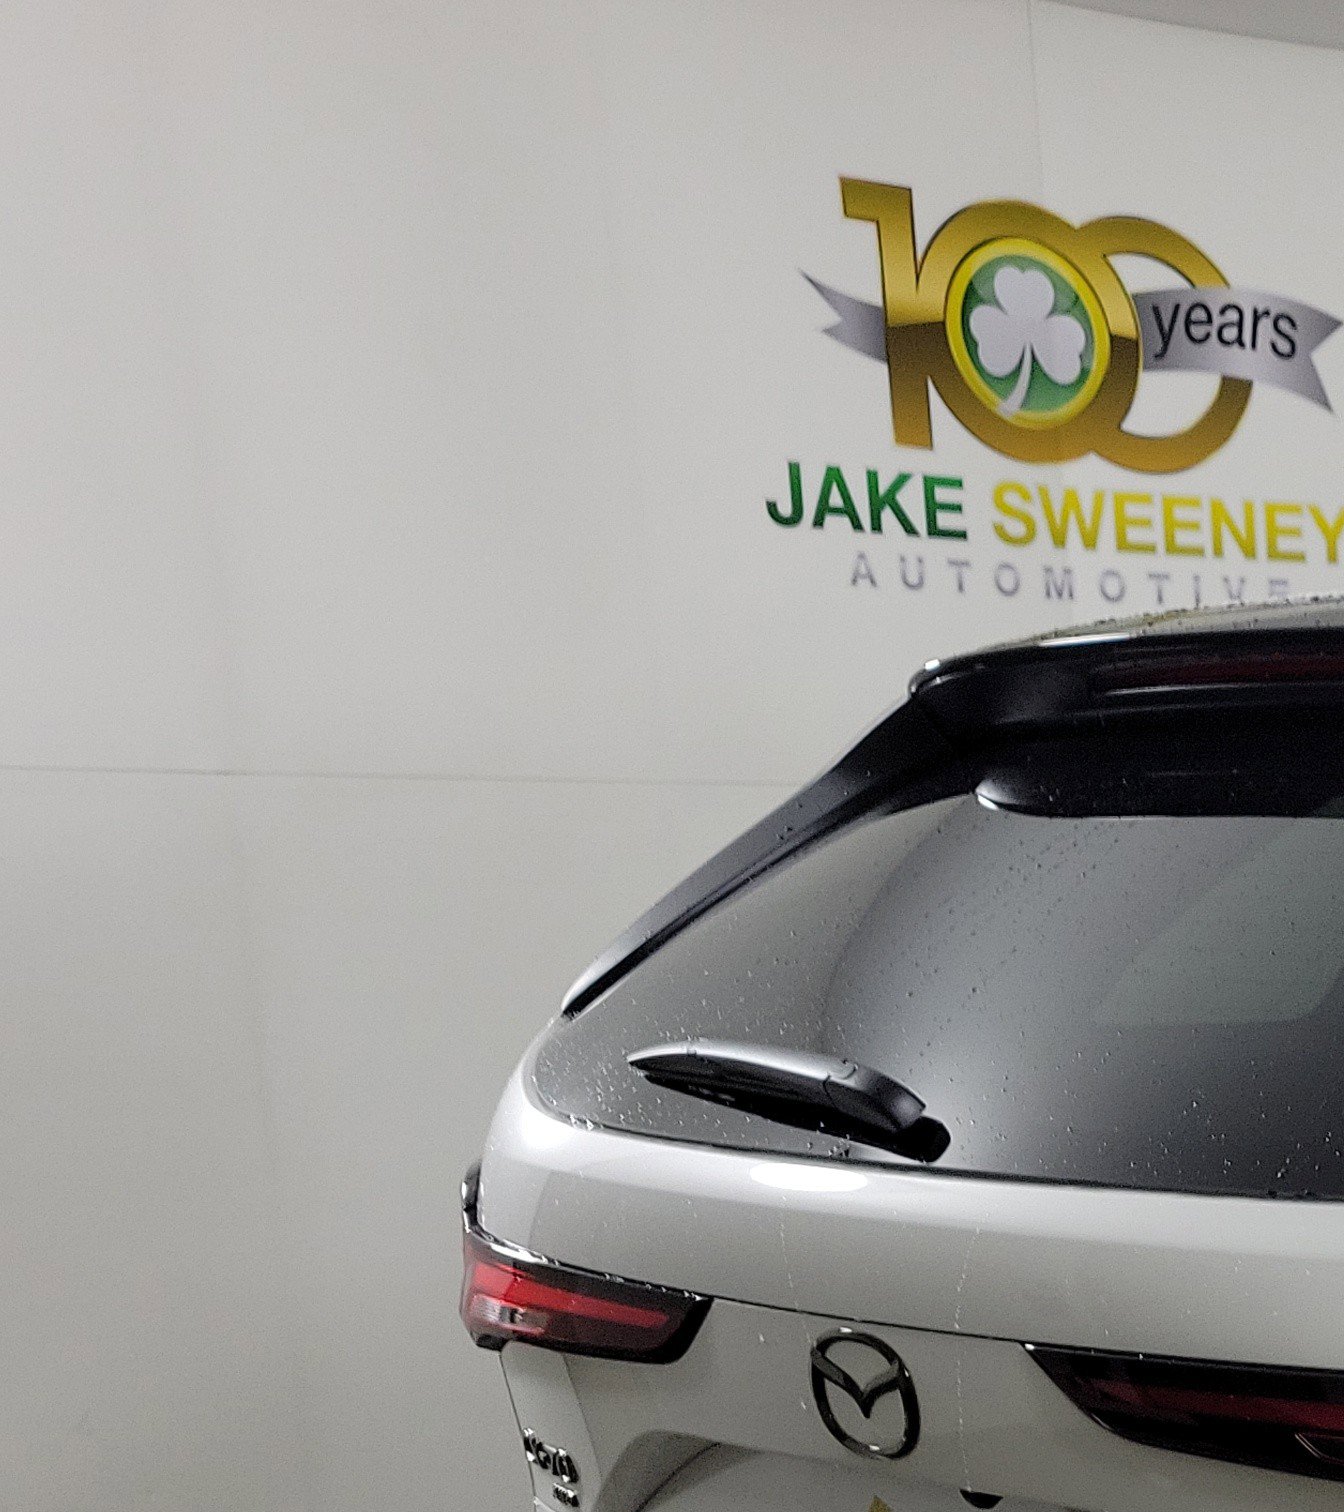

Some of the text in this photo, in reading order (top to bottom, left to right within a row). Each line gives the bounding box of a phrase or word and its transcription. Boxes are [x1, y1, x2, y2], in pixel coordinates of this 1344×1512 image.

[838, 174, 1298, 473] 100 years
[765, 460, 969, 541] JAKE
[850, 551, 1290, 606] AUTOMOTIVE
